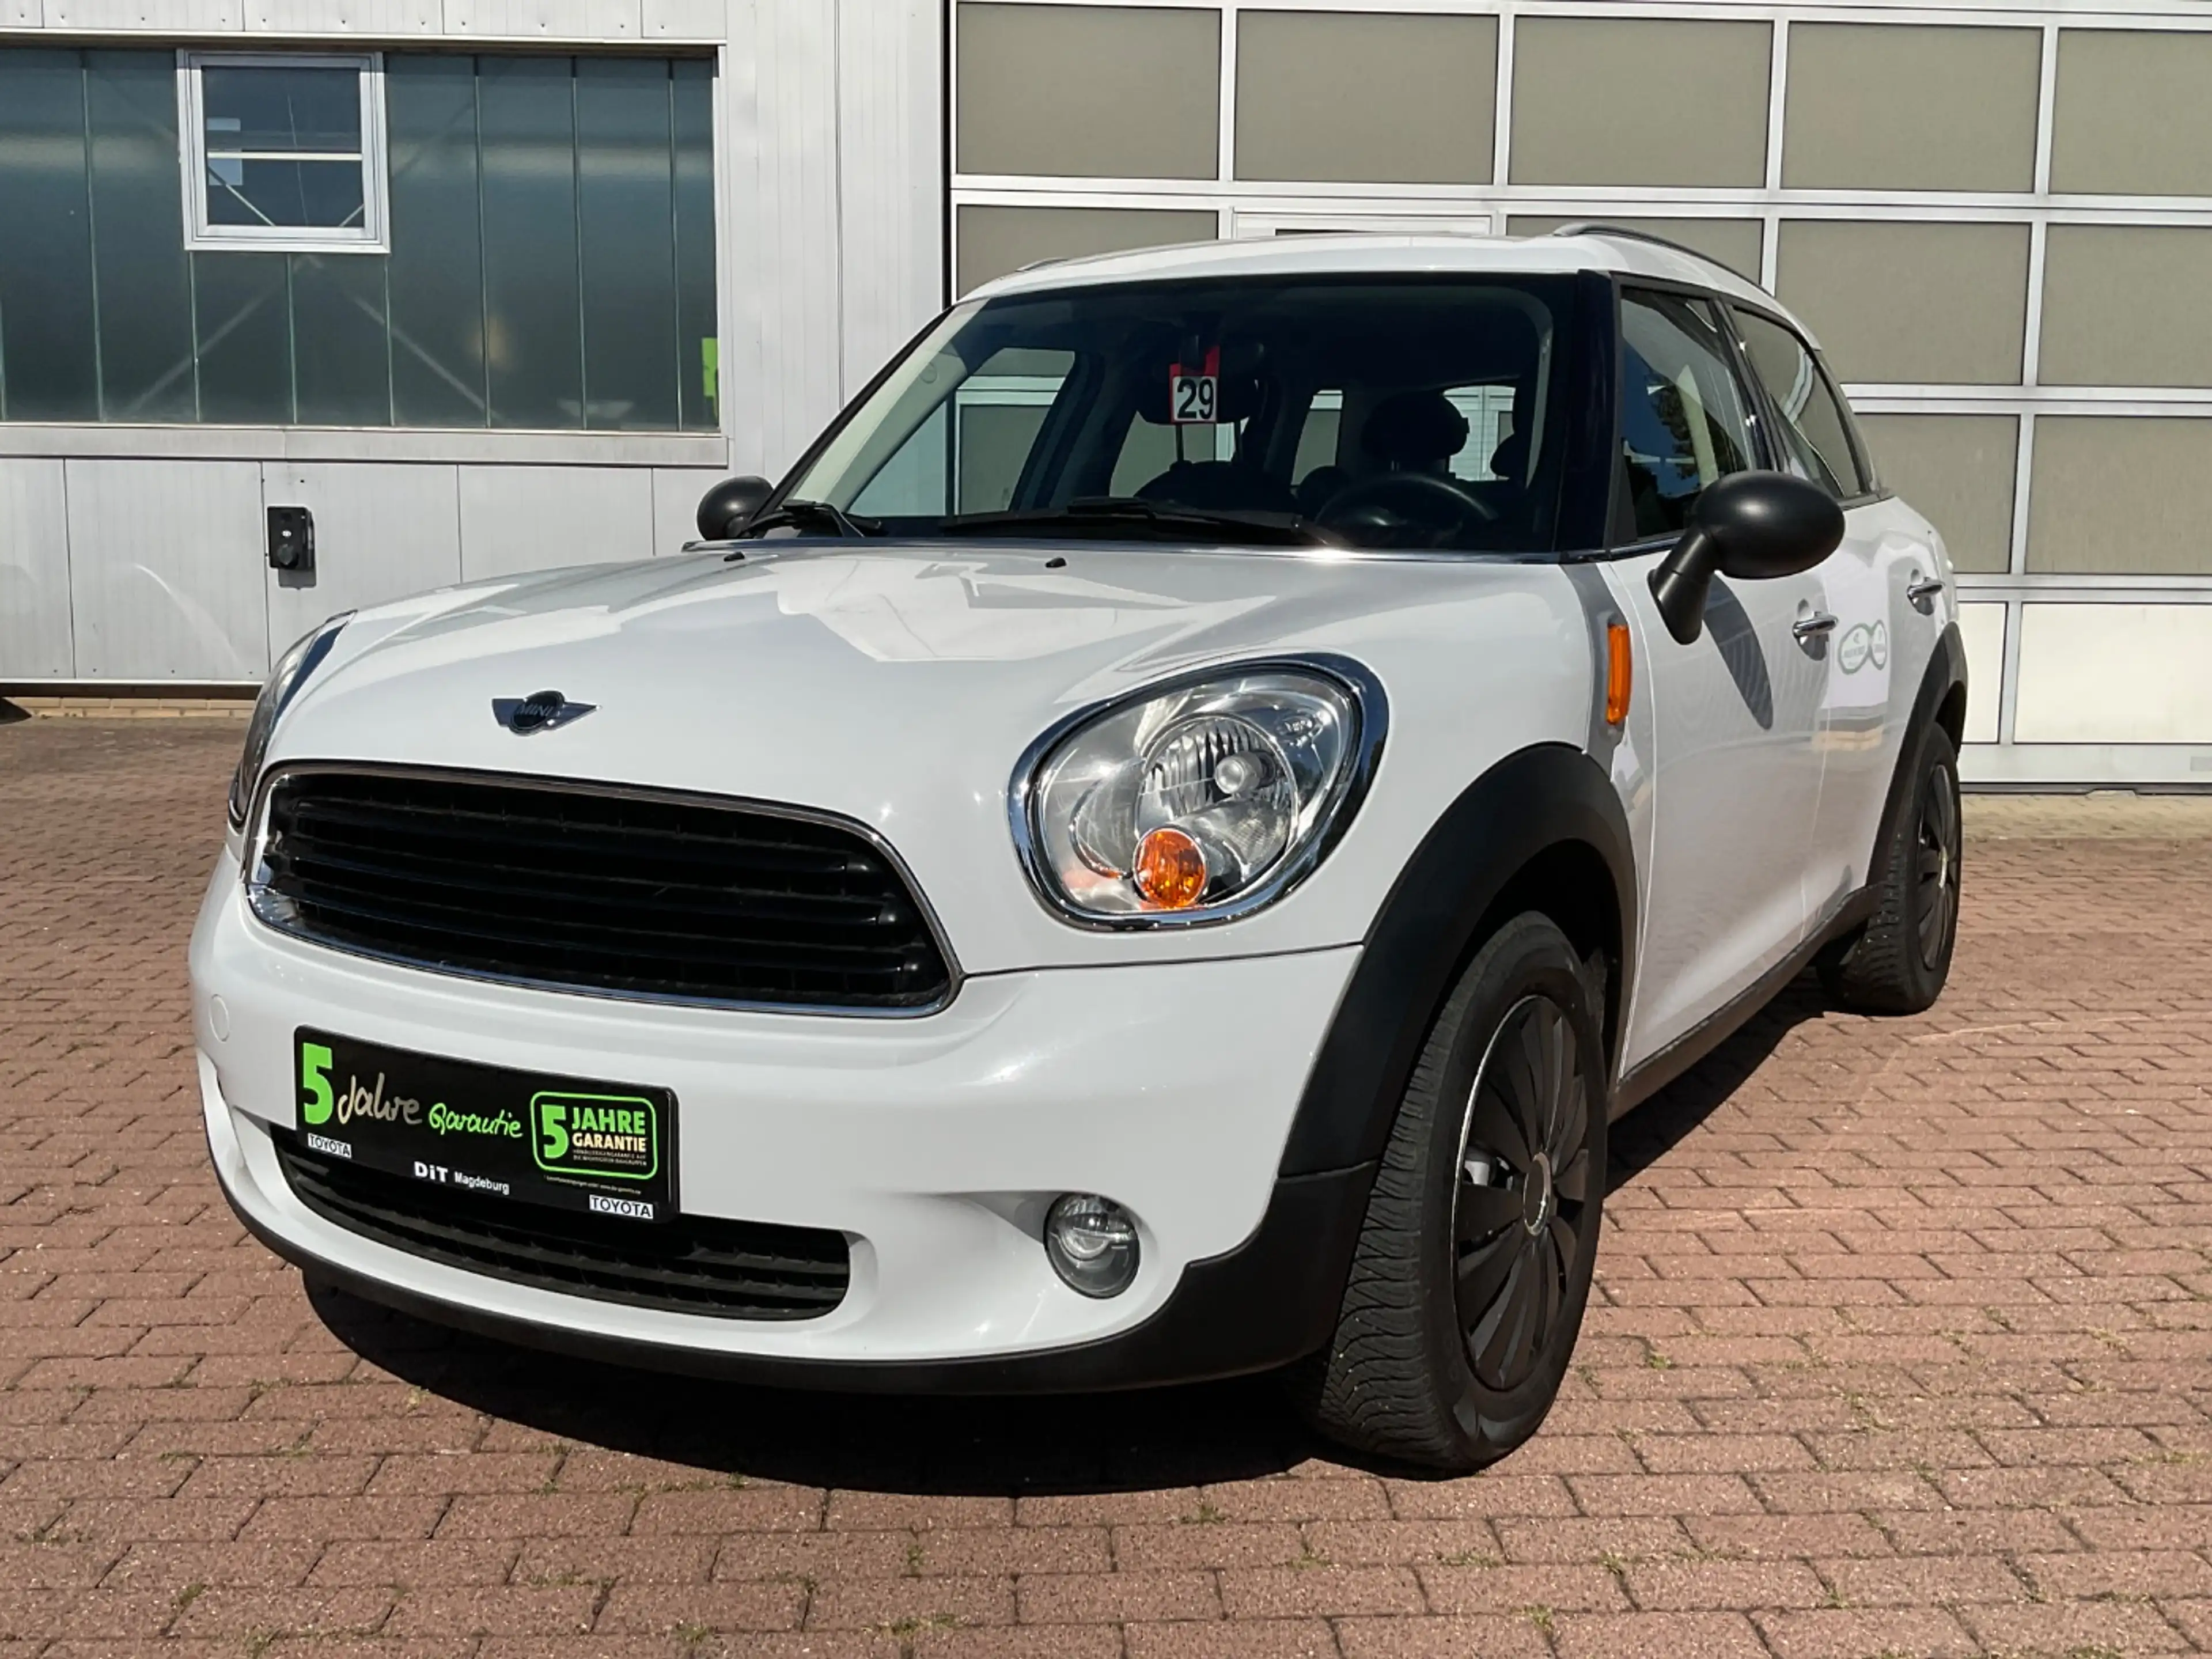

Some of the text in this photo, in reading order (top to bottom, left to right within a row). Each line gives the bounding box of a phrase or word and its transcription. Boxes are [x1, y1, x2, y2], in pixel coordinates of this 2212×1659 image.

[1177, 378, 1214, 420] 29
[302, 1042, 524, 1139] 5 Jahre Garantie
[309, 1134, 351, 1158] TOYOTA
[541, 1104, 646, 1159] 5 JAHRE
[572, 1132, 647, 1153] GARANTIE
[414, 1161, 510, 1195] DiT Magdeburg
[590, 1196, 652, 1219] TOYOTA
